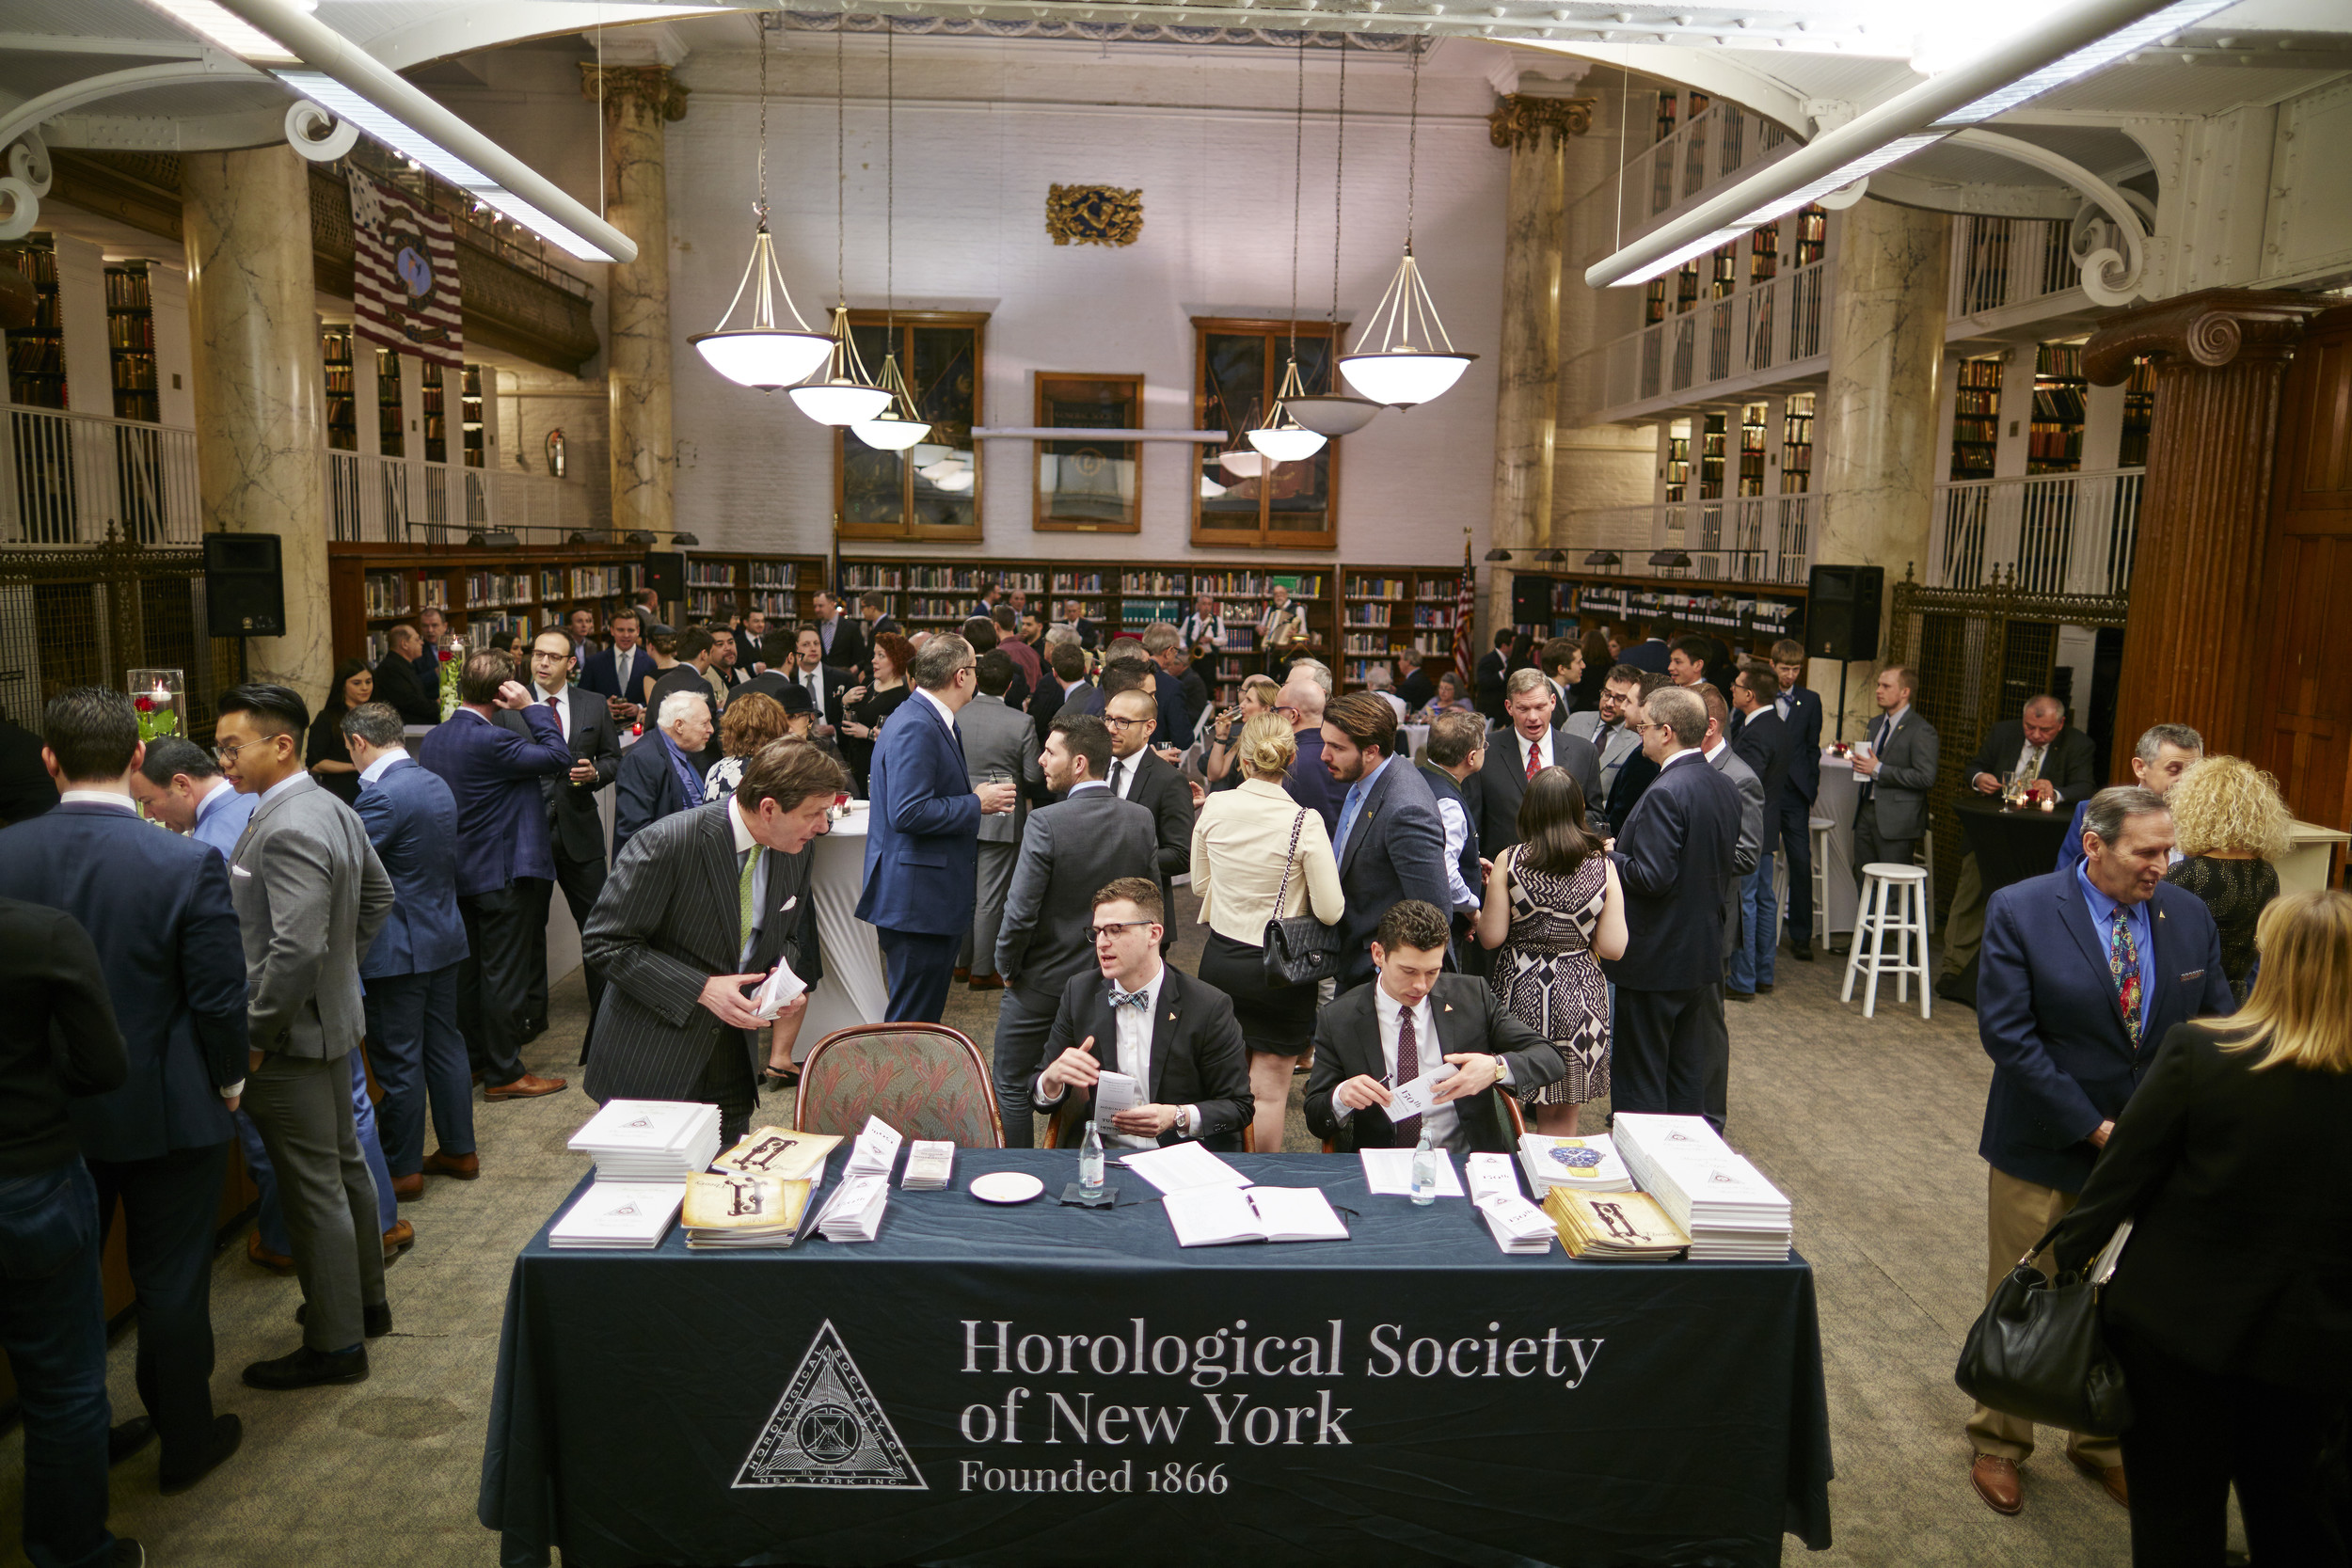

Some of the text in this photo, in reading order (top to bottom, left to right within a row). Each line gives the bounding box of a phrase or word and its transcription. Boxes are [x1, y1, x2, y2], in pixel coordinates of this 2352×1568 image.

[1402, 1089, 1422, 1109] 150th
[961, 1318, 1604, 1389] Horological Society
[749, 1348, 823, 1470] HOROLOGICAL
[834, 1349, 904, 1462] SOCIETY OF
[961, 1387, 1352, 1446] of New York
[960, 1460, 1229, 1495] Founded 1866
